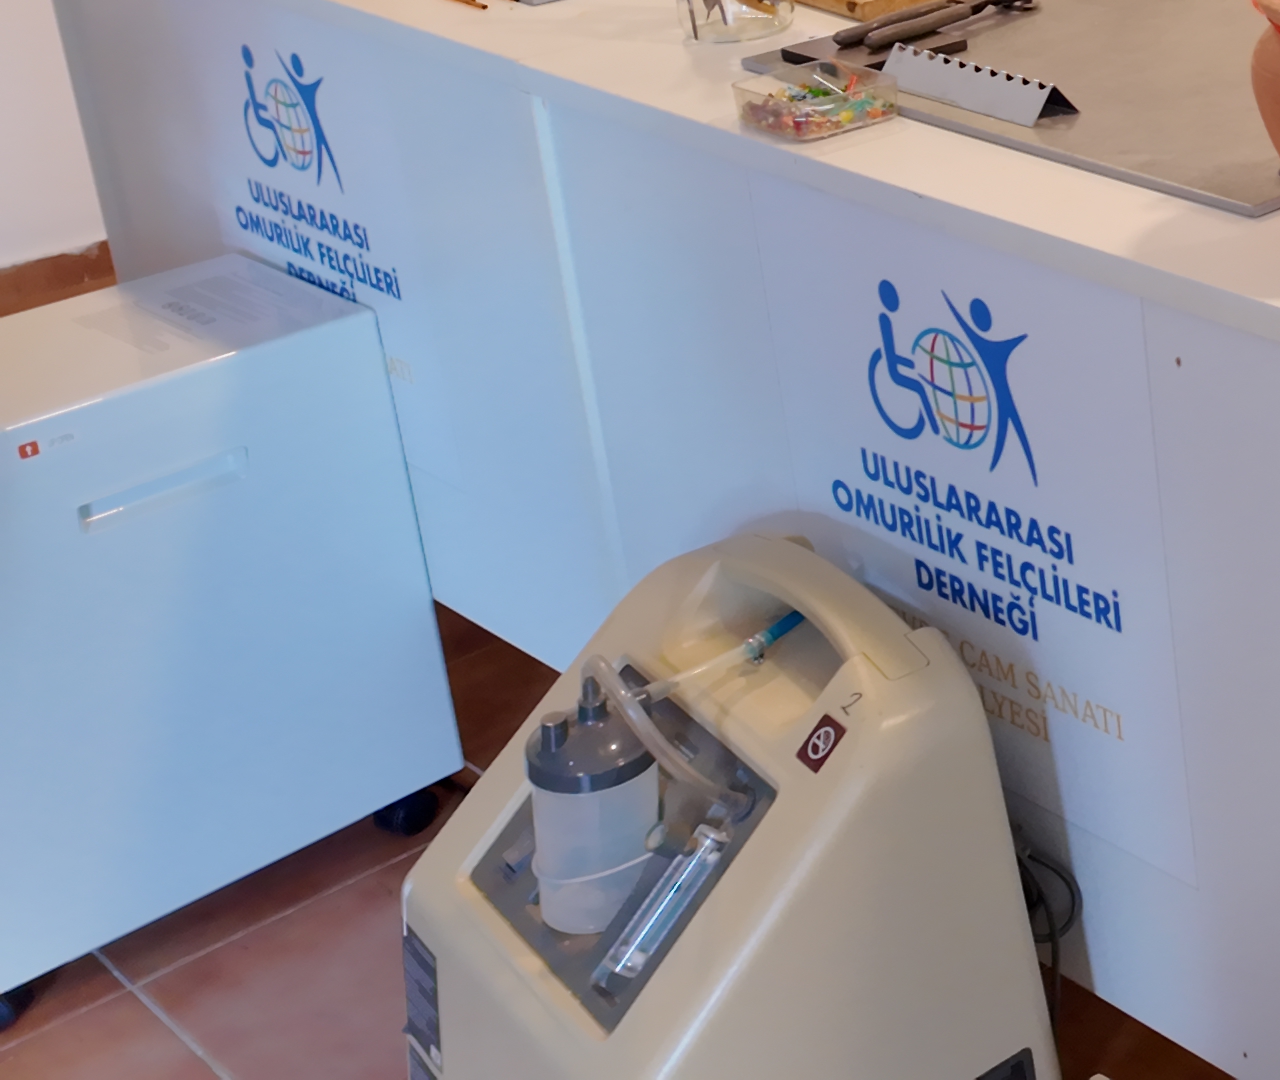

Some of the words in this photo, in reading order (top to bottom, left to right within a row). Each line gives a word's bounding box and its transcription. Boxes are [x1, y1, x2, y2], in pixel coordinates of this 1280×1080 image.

[235, 205, 315, 261] OMURİLİK
[317, 242, 402, 301] FELÇLİLERİ
[247, 178, 370, 251] ULUSLARARASI
[860, 447, 1074, 565] ULUSLARARASI
[831, 479, 968, 565] OMURİLİK
[975, 539, 1122, 634] FELÇLİLERİ
[914, 558, 1039, 642] DERNEĞİ
[959, 640, 1018, 689] CAM
[1025, 671, 1125, 742] SANATI
